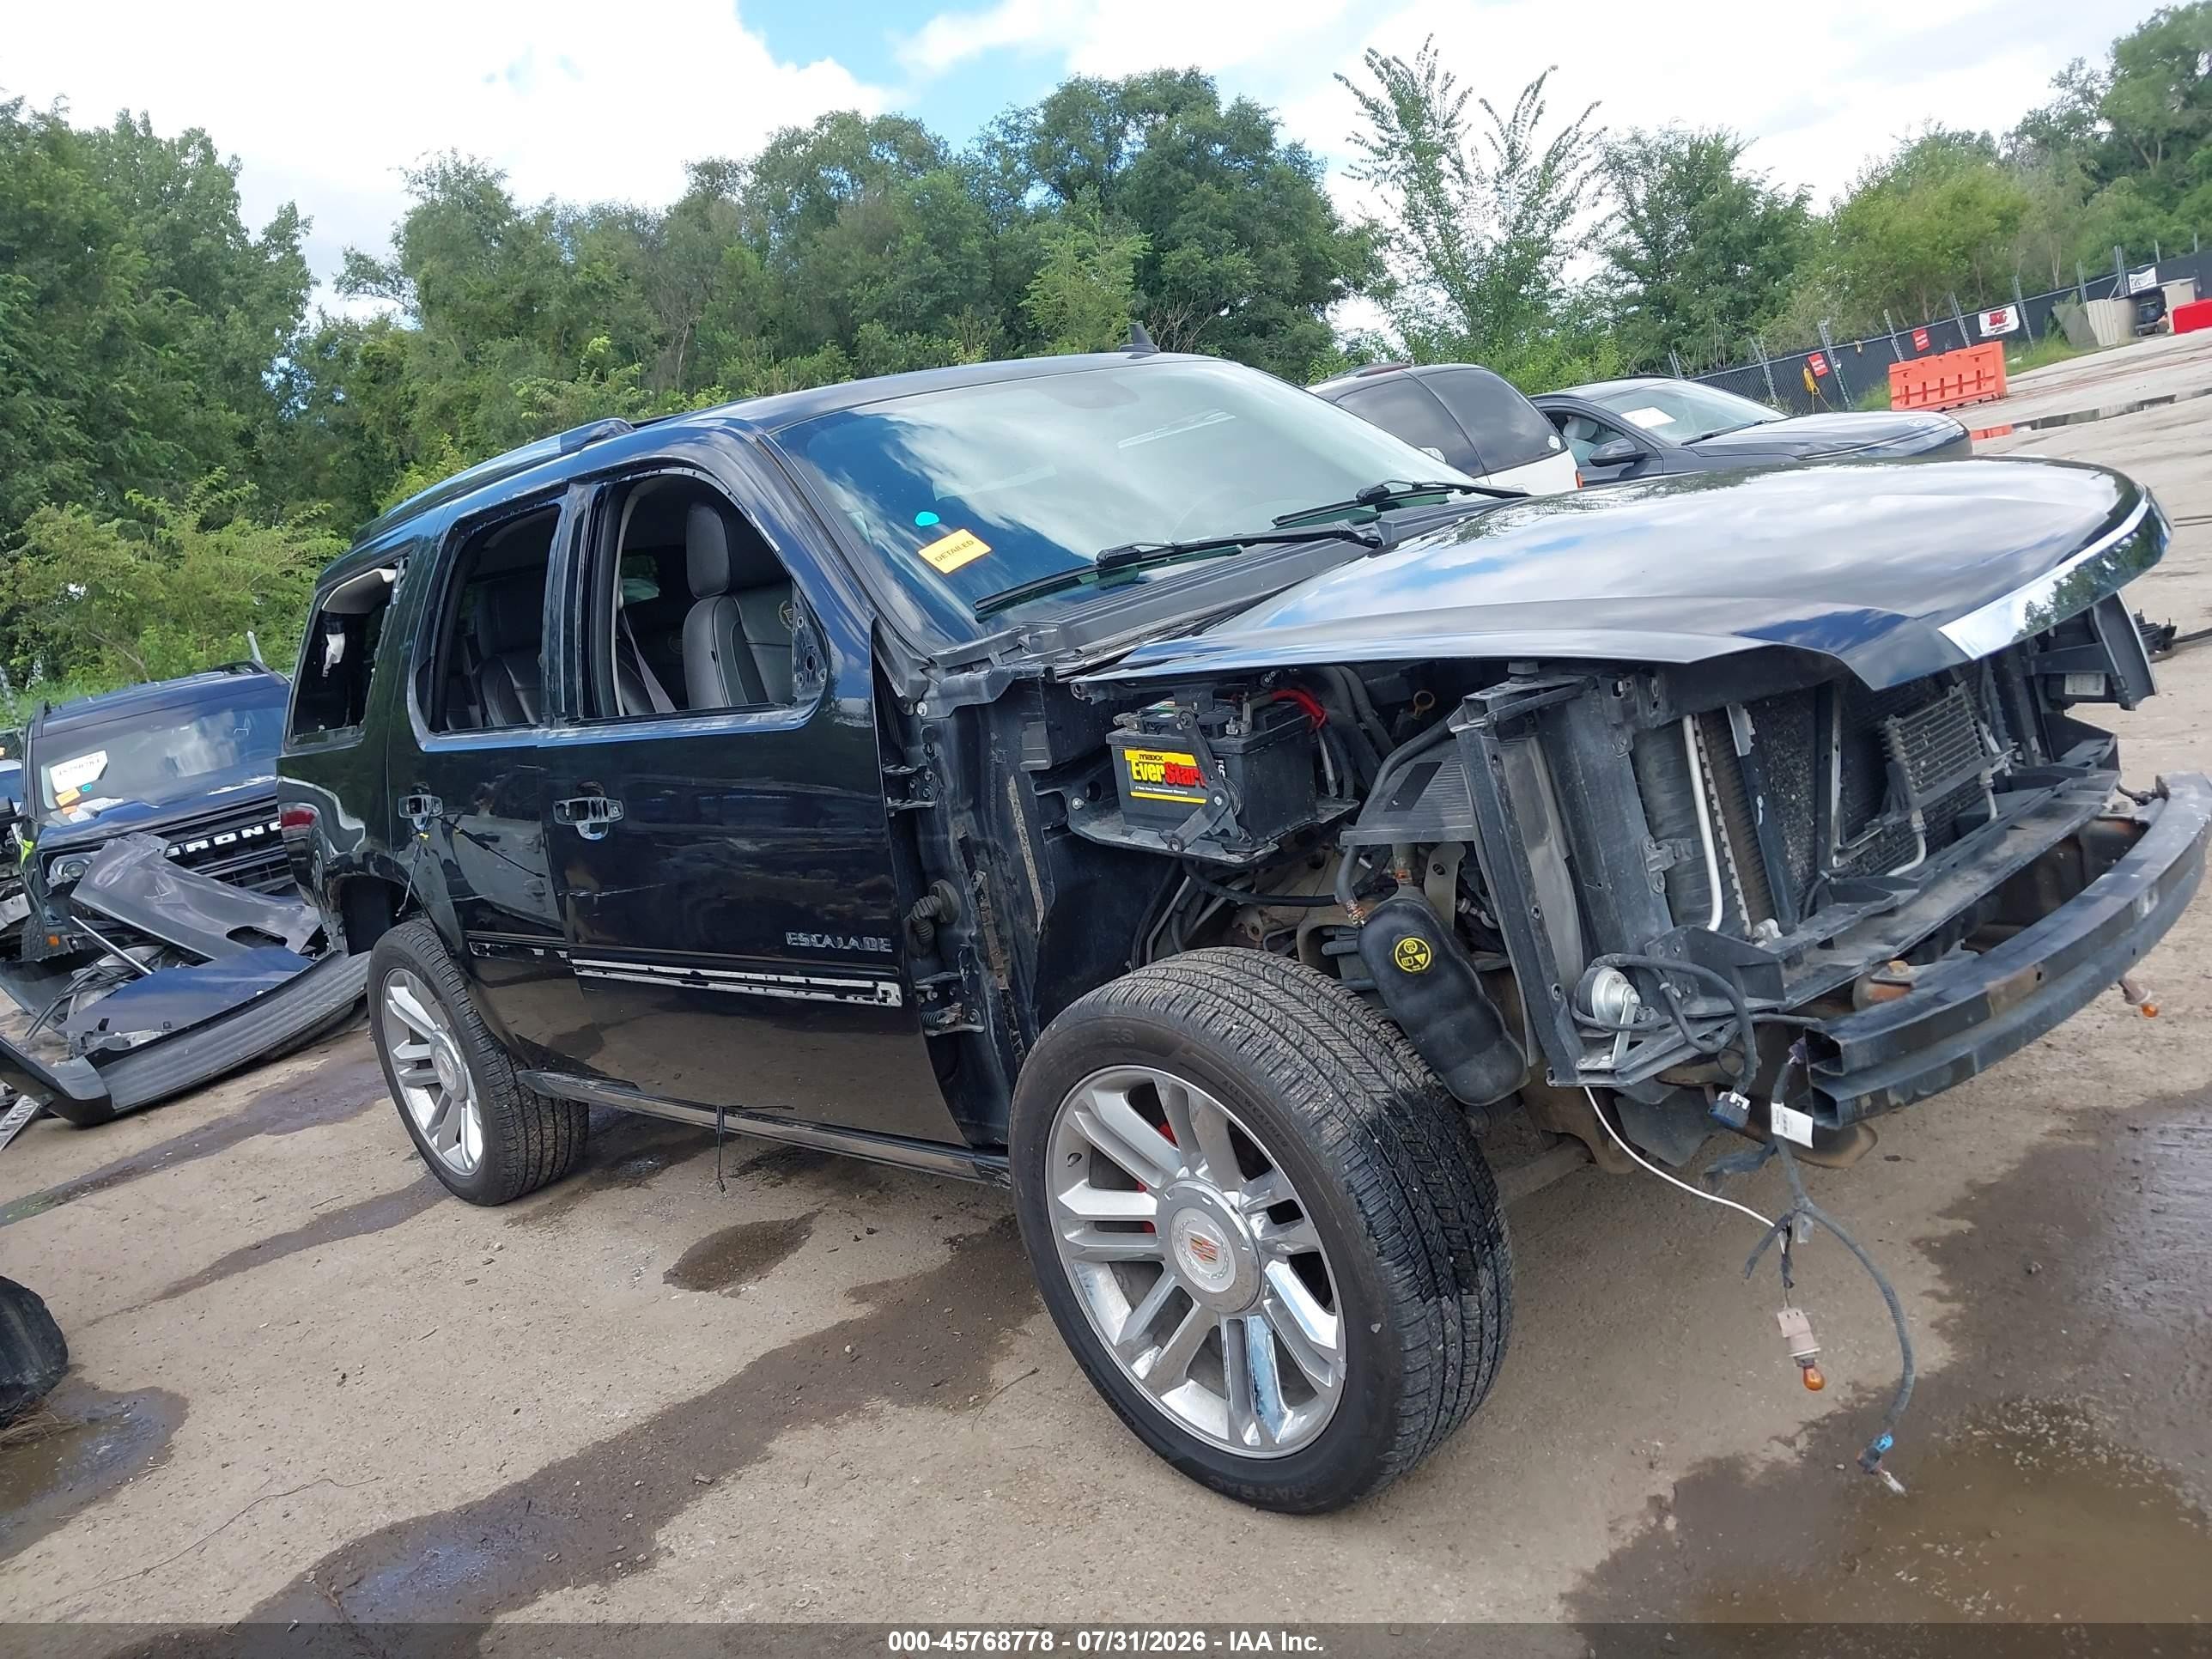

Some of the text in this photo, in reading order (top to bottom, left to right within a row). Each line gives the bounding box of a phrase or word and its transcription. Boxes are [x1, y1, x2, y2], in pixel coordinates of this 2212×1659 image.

[934, 539, 975, 563] DETAILED
[1139, 753, 1164, 762] maxx
[165, 821, 282, 858] BRONC
[785, 931, 893, 953] ESCALADE
